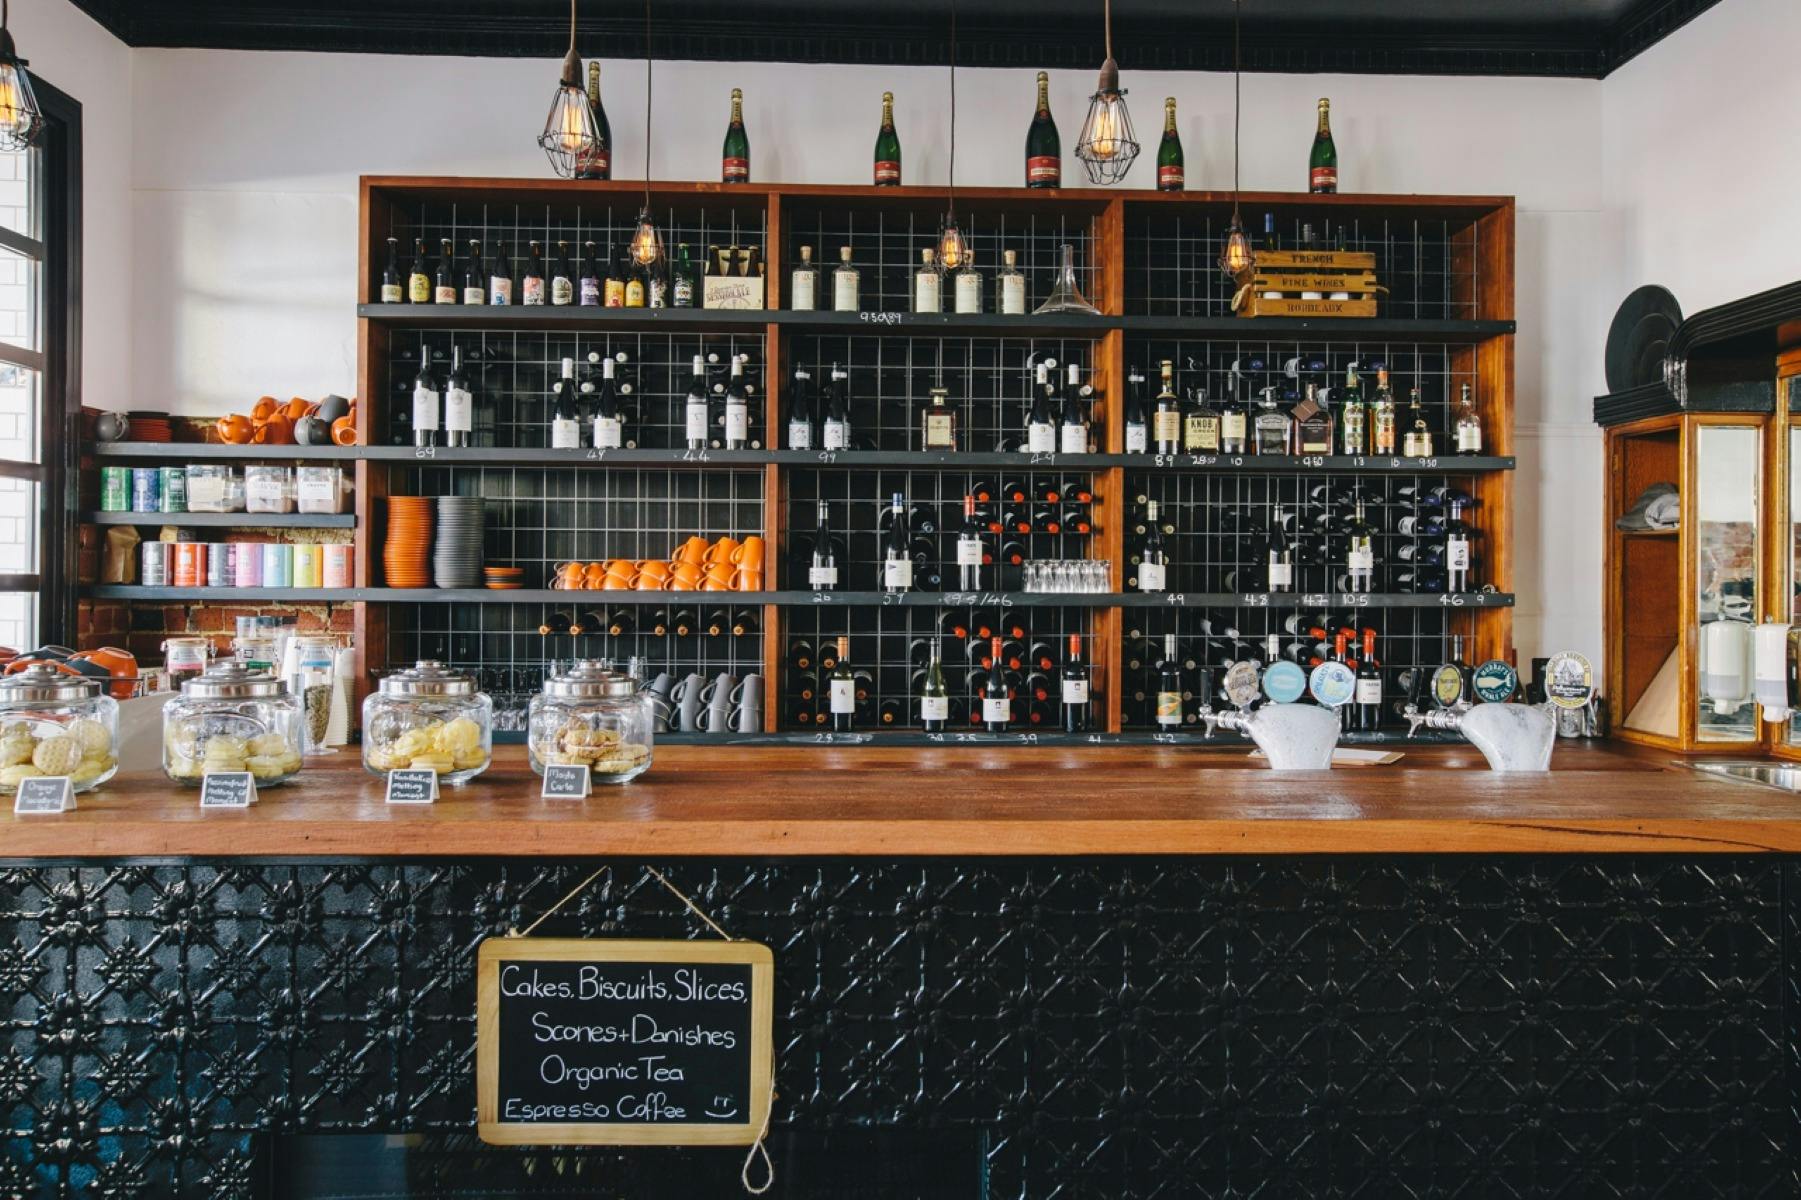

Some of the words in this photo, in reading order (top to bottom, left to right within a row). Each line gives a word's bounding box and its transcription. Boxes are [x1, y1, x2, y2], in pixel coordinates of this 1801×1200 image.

[1291, 254, 1333, 264] FRENCH
[1282, 278, 1309, 288] FINE
[1313, 278, 1345, 288] WINES
[1287, 303, 1343, 313] BORDEAUX
[1167, 593, 1185, 605] 49
[578, 965, 672, 1001] Biscuits,
[674, 968, 748, 1003] Slices,
[540, 1054, 638, 1091] Organic
[638, 1055, 685, 1082] Tea
[505, 1097, 610, 1121] Espresso
[616, 1091, 687, 1121] Coffee
